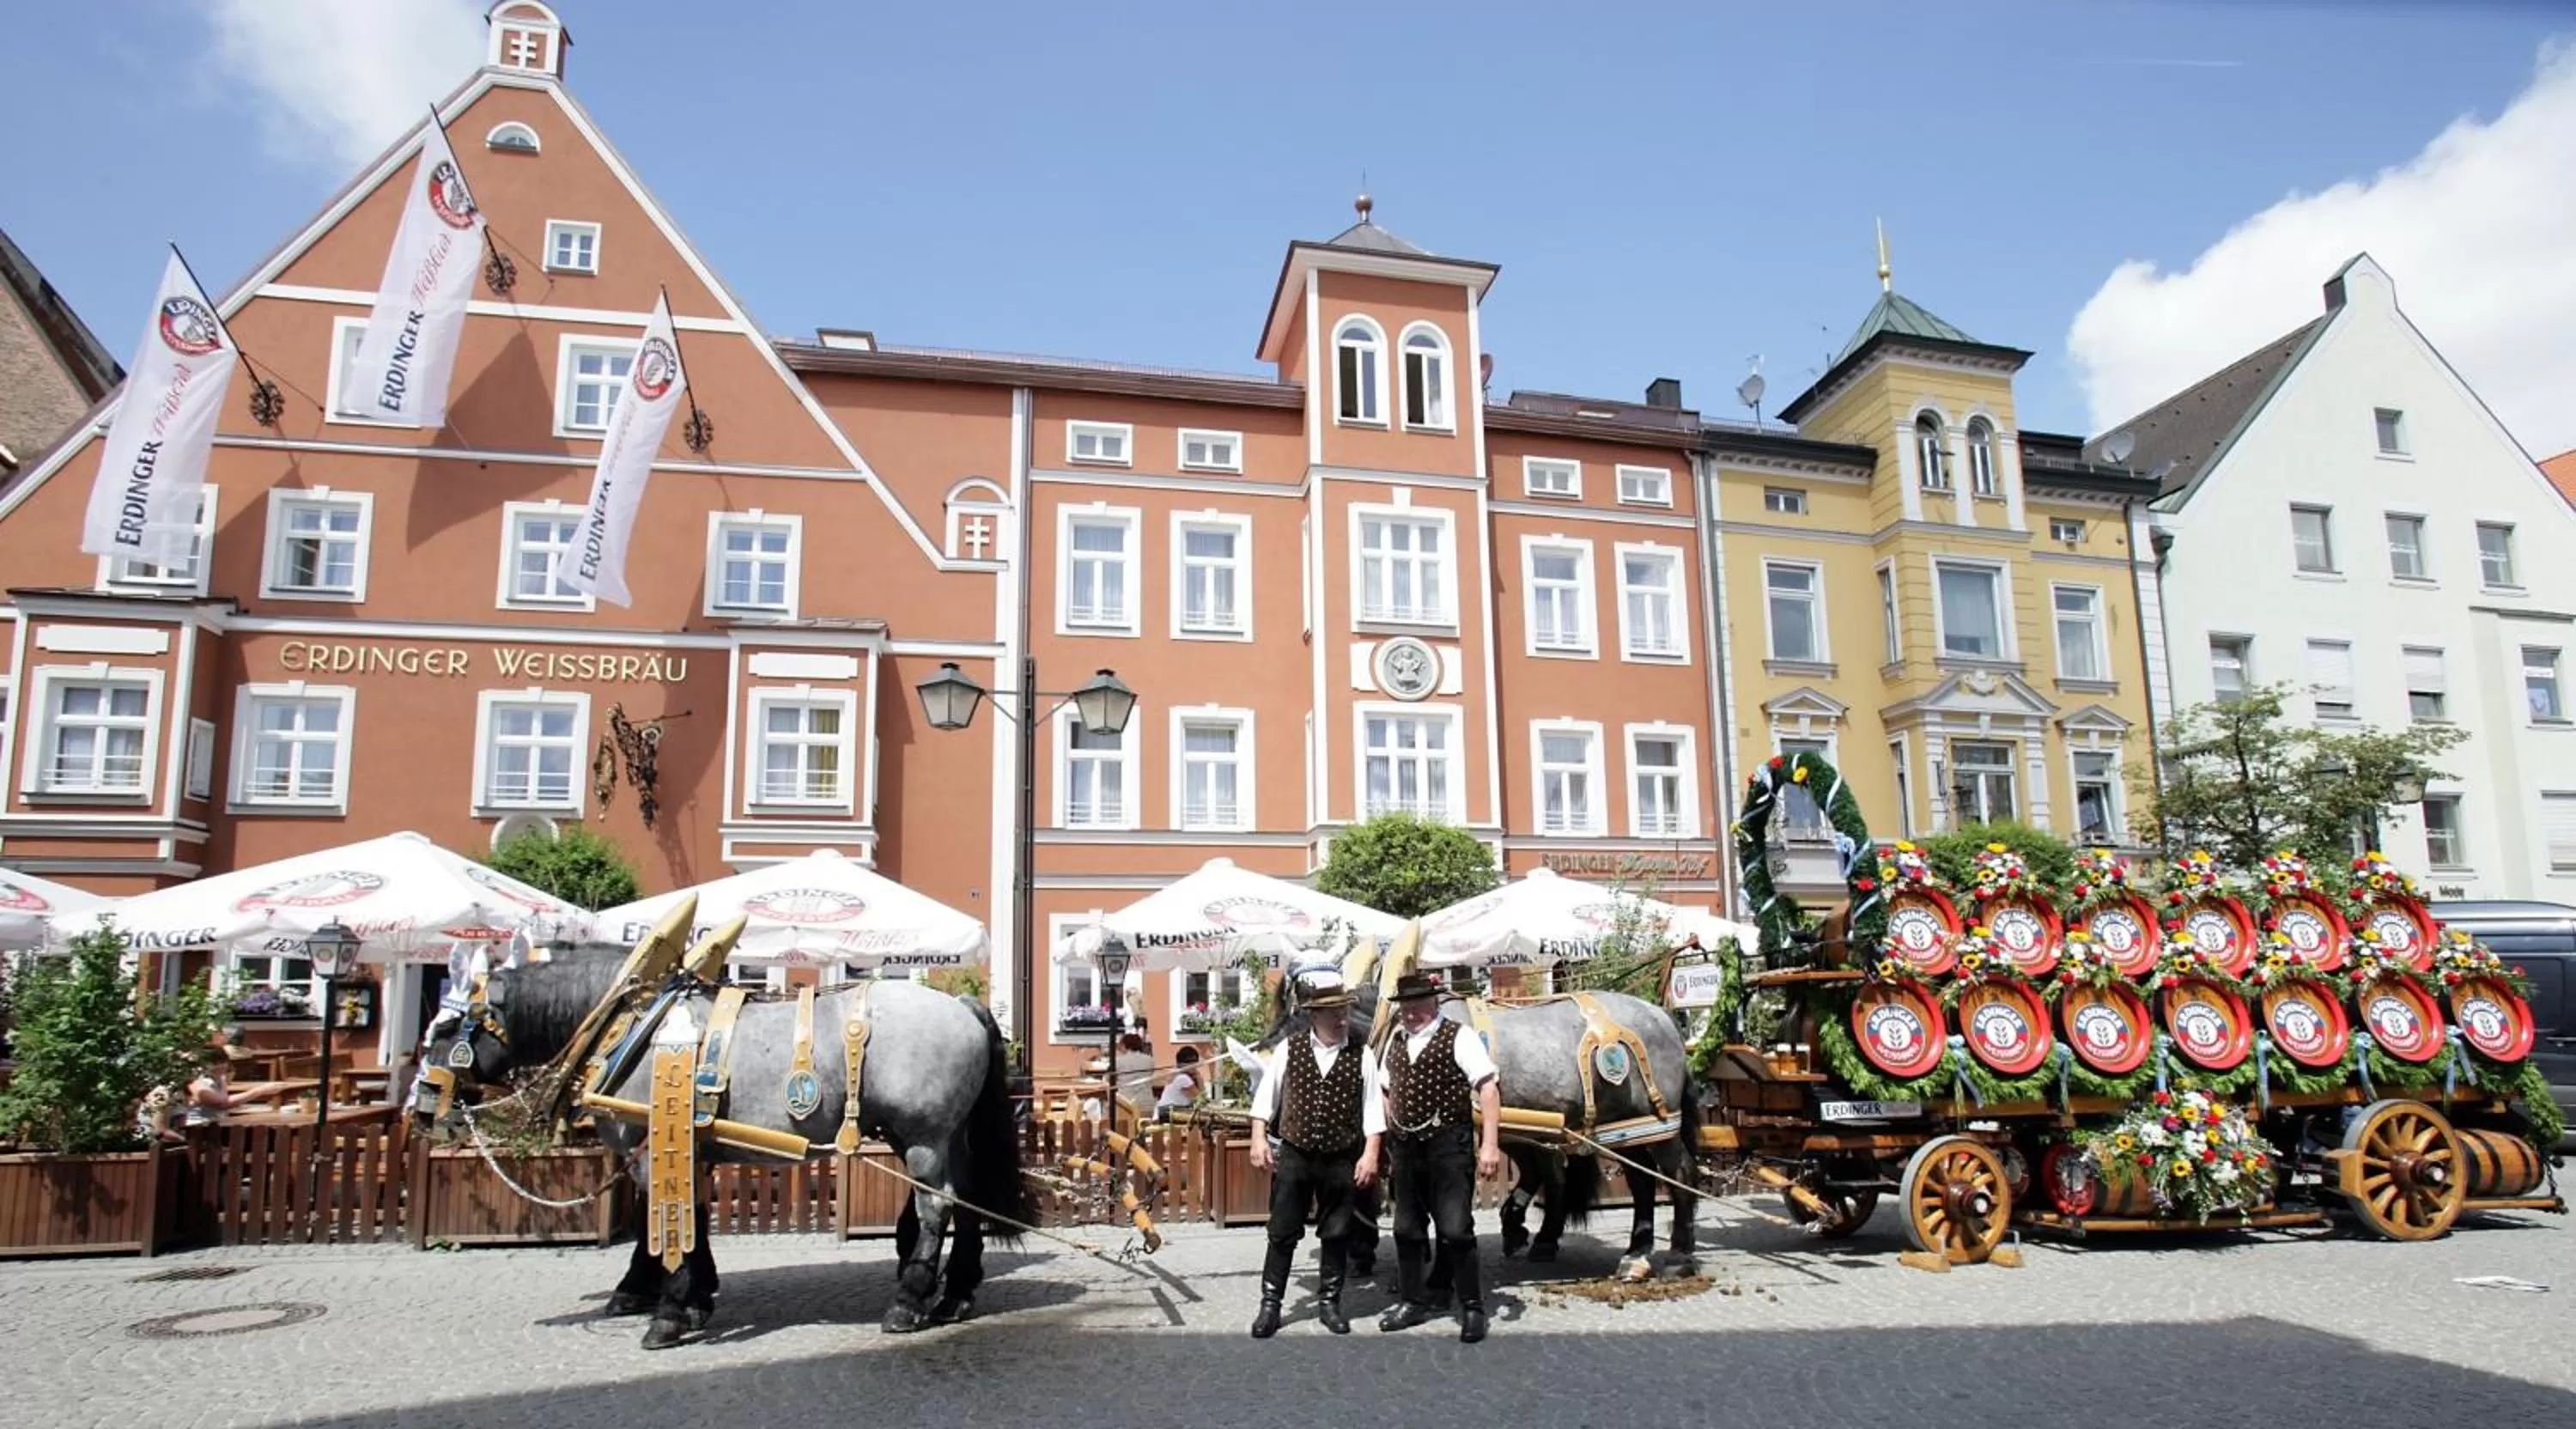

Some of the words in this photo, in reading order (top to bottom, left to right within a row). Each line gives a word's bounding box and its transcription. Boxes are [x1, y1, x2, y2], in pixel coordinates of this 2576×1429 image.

[378, 310, 424, 413] ERDINGER
[114, 441, 164, 548] ERDINGER
[280, 641, 469, 676] ERDINGER
[494, 647, 688, 684] WEISSBRÄU
[1826, 1103, 1883, 1117] ERDINGER
